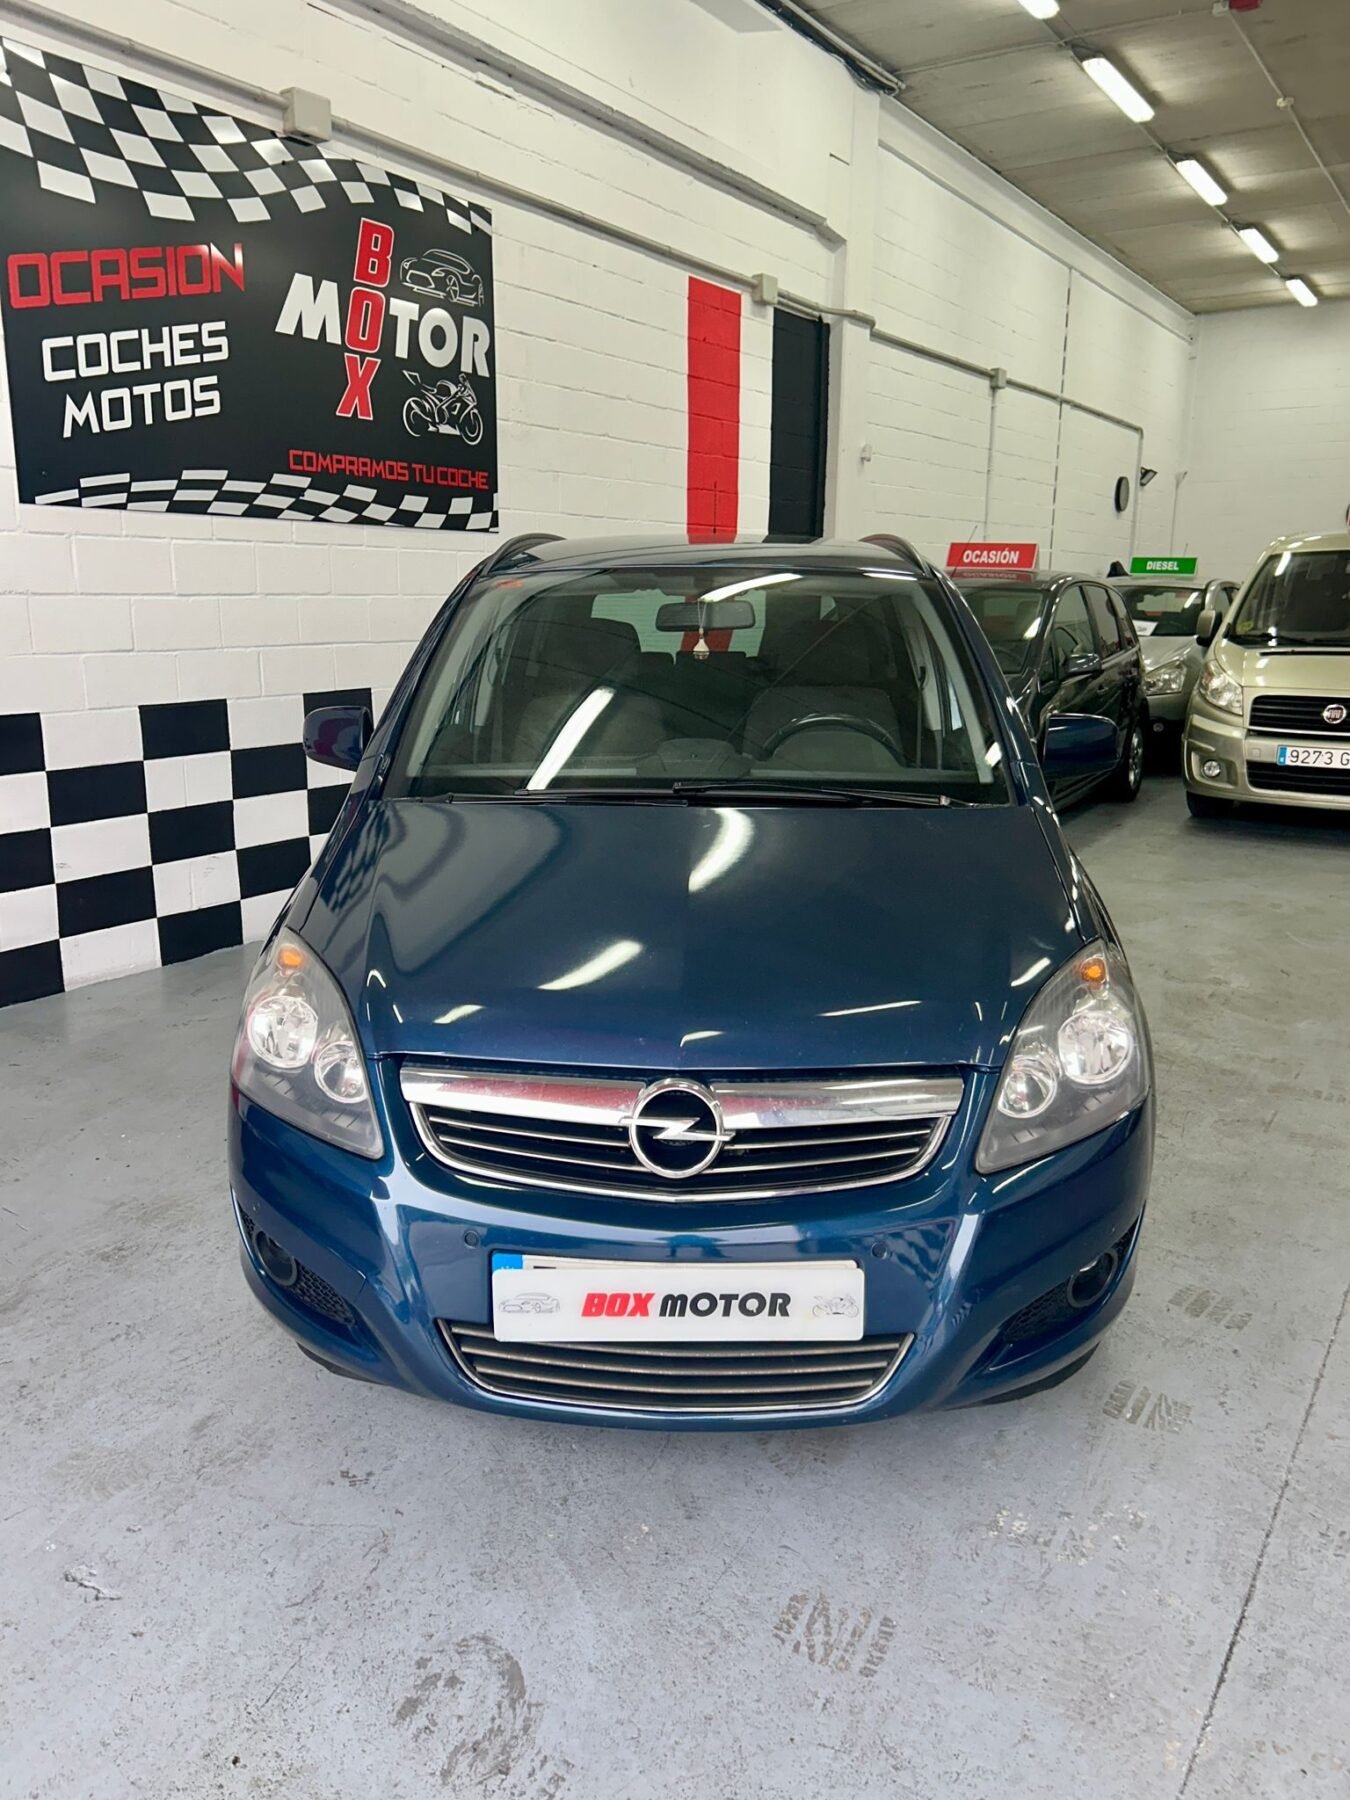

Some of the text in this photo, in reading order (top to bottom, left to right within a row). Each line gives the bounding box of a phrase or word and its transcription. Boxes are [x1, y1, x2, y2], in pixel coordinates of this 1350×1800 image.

[7, 242, 246, 309] OCASION
[275, 272, 491, 378] MOTOR
[336, 216, 395, 421] BOX
[41, 320, 230, 383] COCHES
[63, 375, 221, 438] MOTOS
[288, 449, 489, 490] COMPRAMOS TU COCHE
[962, 548, 1020, 565] OCASIÓN
[1146, 560, 1179, 571] DIESEL
[1289, 749, 1334, 766] 9273
[581, 1292, 791, 1318] BOX MOTOR
